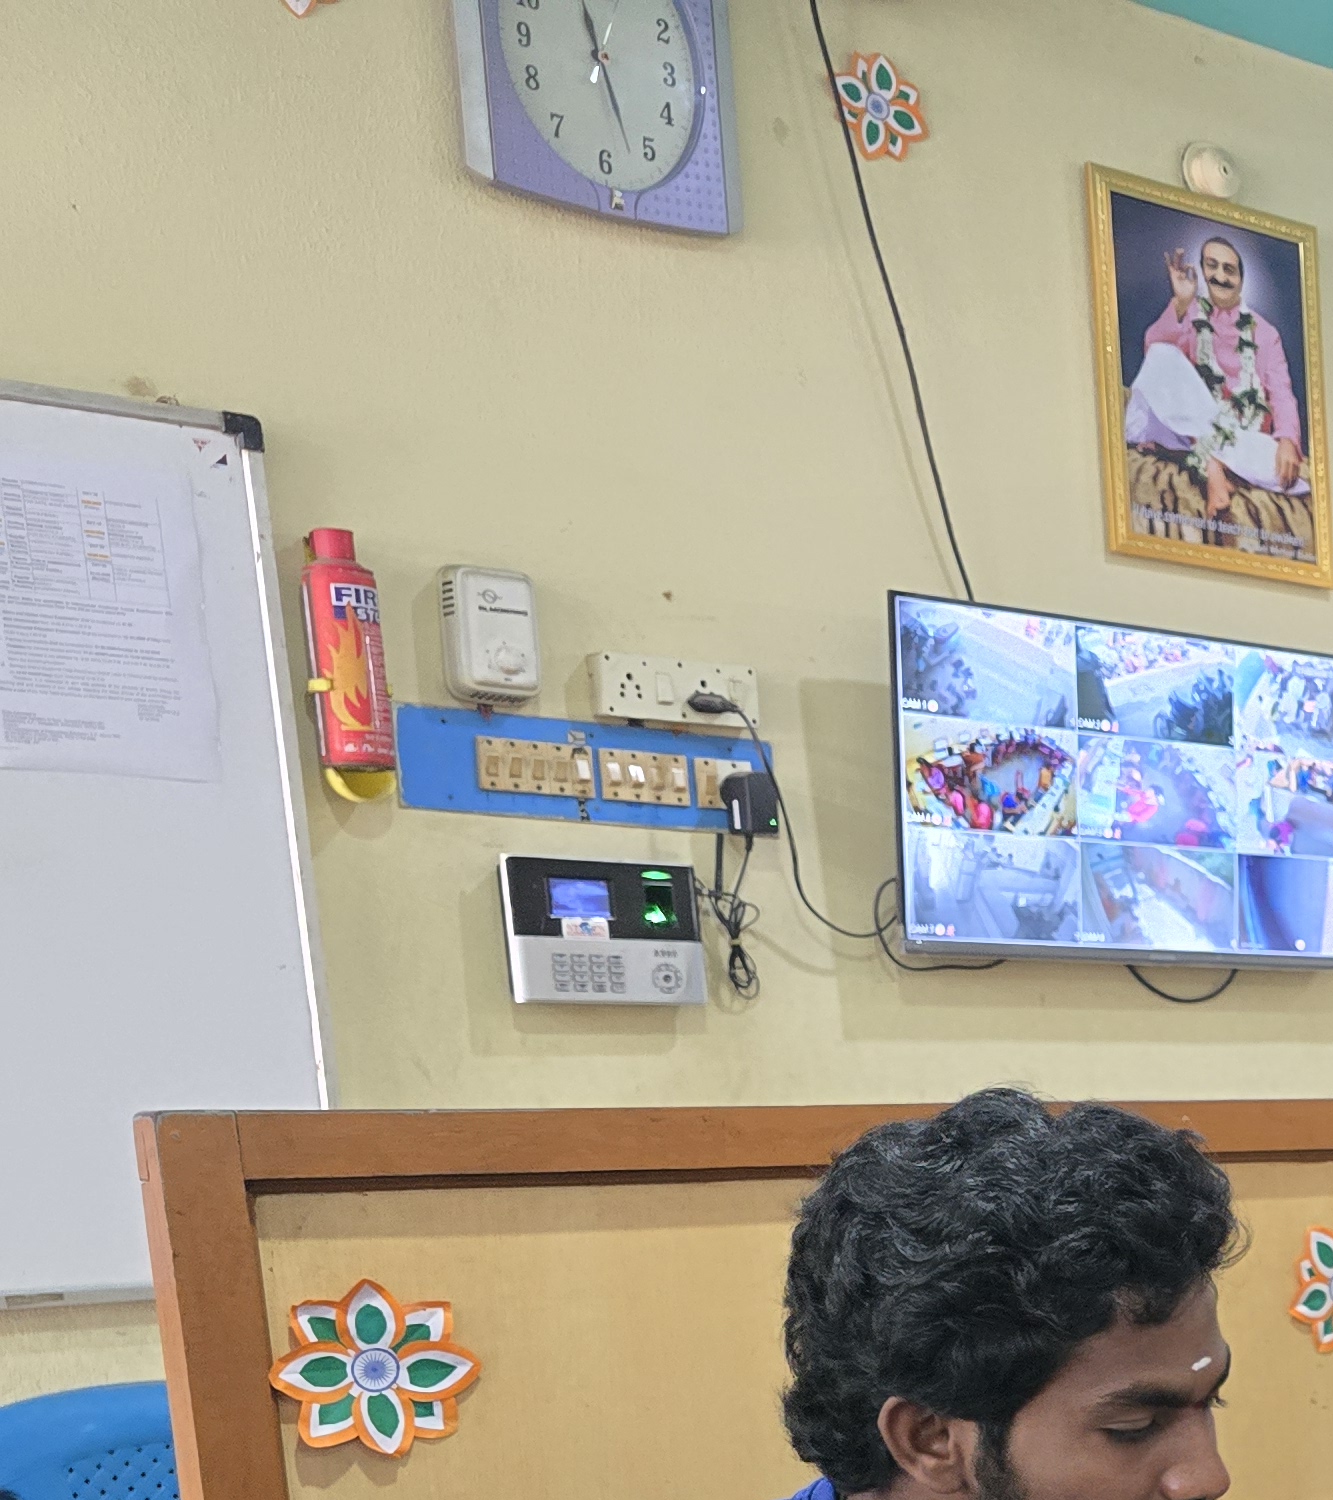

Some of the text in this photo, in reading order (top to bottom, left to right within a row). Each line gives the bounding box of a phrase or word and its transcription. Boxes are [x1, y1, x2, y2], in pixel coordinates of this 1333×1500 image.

[517, 21, 531, 47] 9
[656, 18, 671, 44] 2
[525, 64, 540, 91] 8
[662, 62, 676, 87] 3
[550, 112, 564, 138] 7
[660, 101, 674, 127] 4
[599, 149, 613, 175] 6
[642, 136, 656, 162] 5
